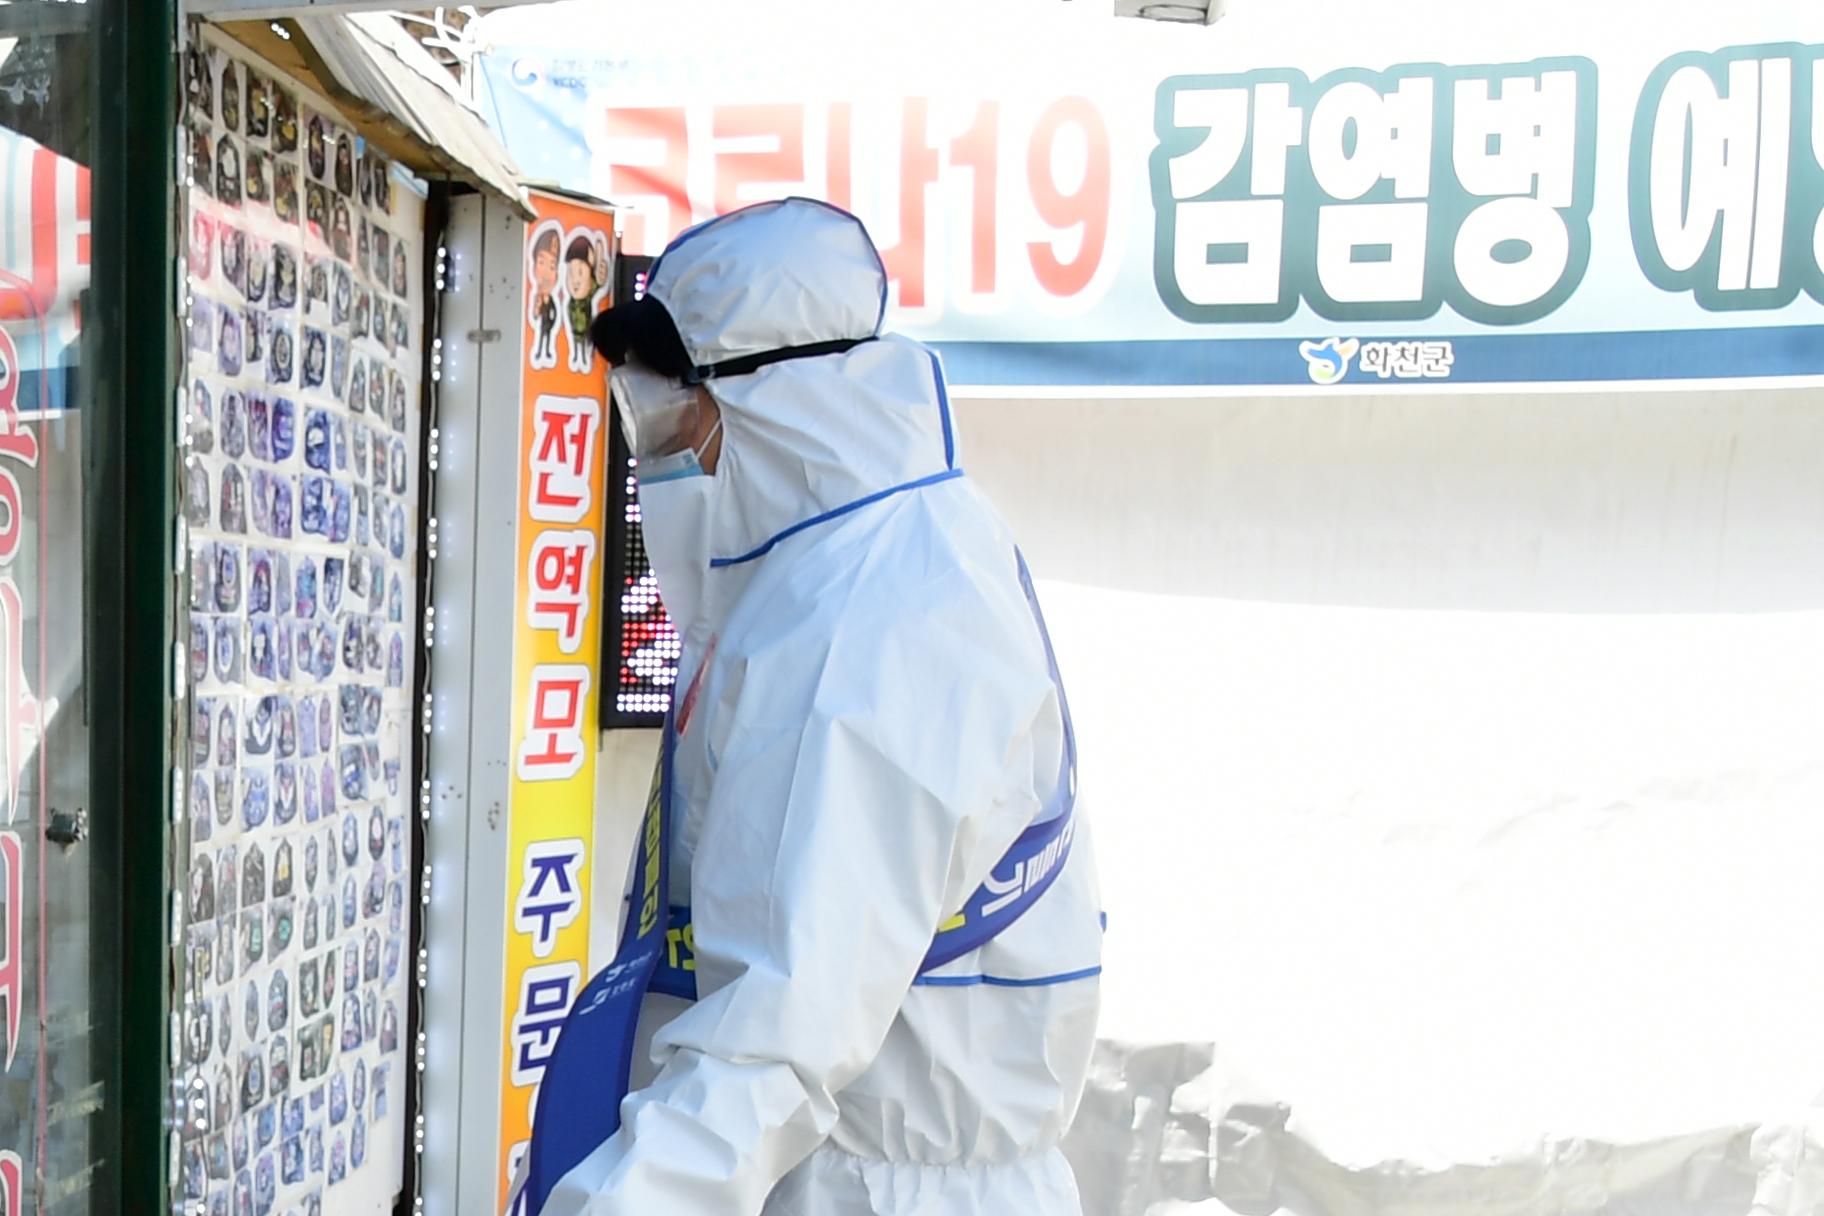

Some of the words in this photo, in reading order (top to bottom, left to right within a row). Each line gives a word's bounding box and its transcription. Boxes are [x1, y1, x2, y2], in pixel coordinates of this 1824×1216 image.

[1164, 68, 1584, 312] 감염병
[1644, 52, 1824, 294] 예
[1363, 343, 1451, 374] 화천군
